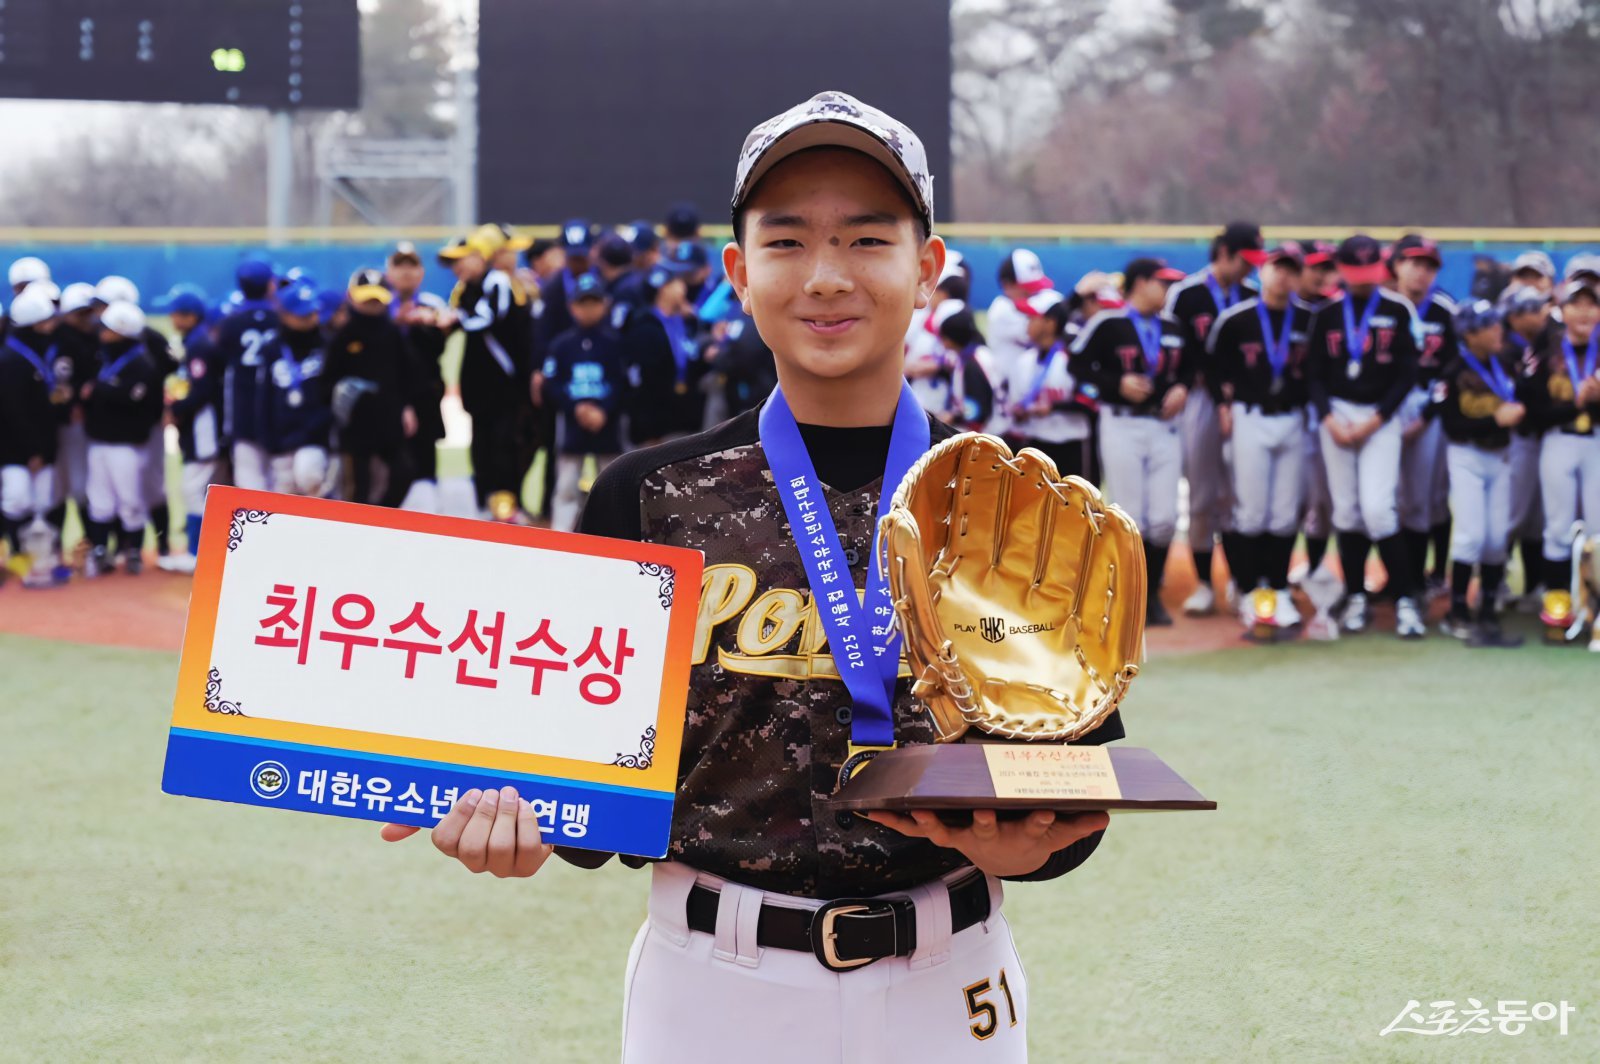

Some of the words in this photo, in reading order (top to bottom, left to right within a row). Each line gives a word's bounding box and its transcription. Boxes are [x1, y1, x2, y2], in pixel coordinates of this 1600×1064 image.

[790, 476, 838, 583] 전국유소년야구대회
[827, 590, 852, 626] 서울컵
[954, 623, 976, 633] PLAY
[981, 617, 1004, 642] HK
[1009, 622, 1056, 634] BASEBALL
[254, 583, 635, 705] 최우수선수상
[843, 634, 864, 668] 2025
[297, 768, 591, 838] 대한유소년연맹
[962, 968, 1017, 1041] 51
